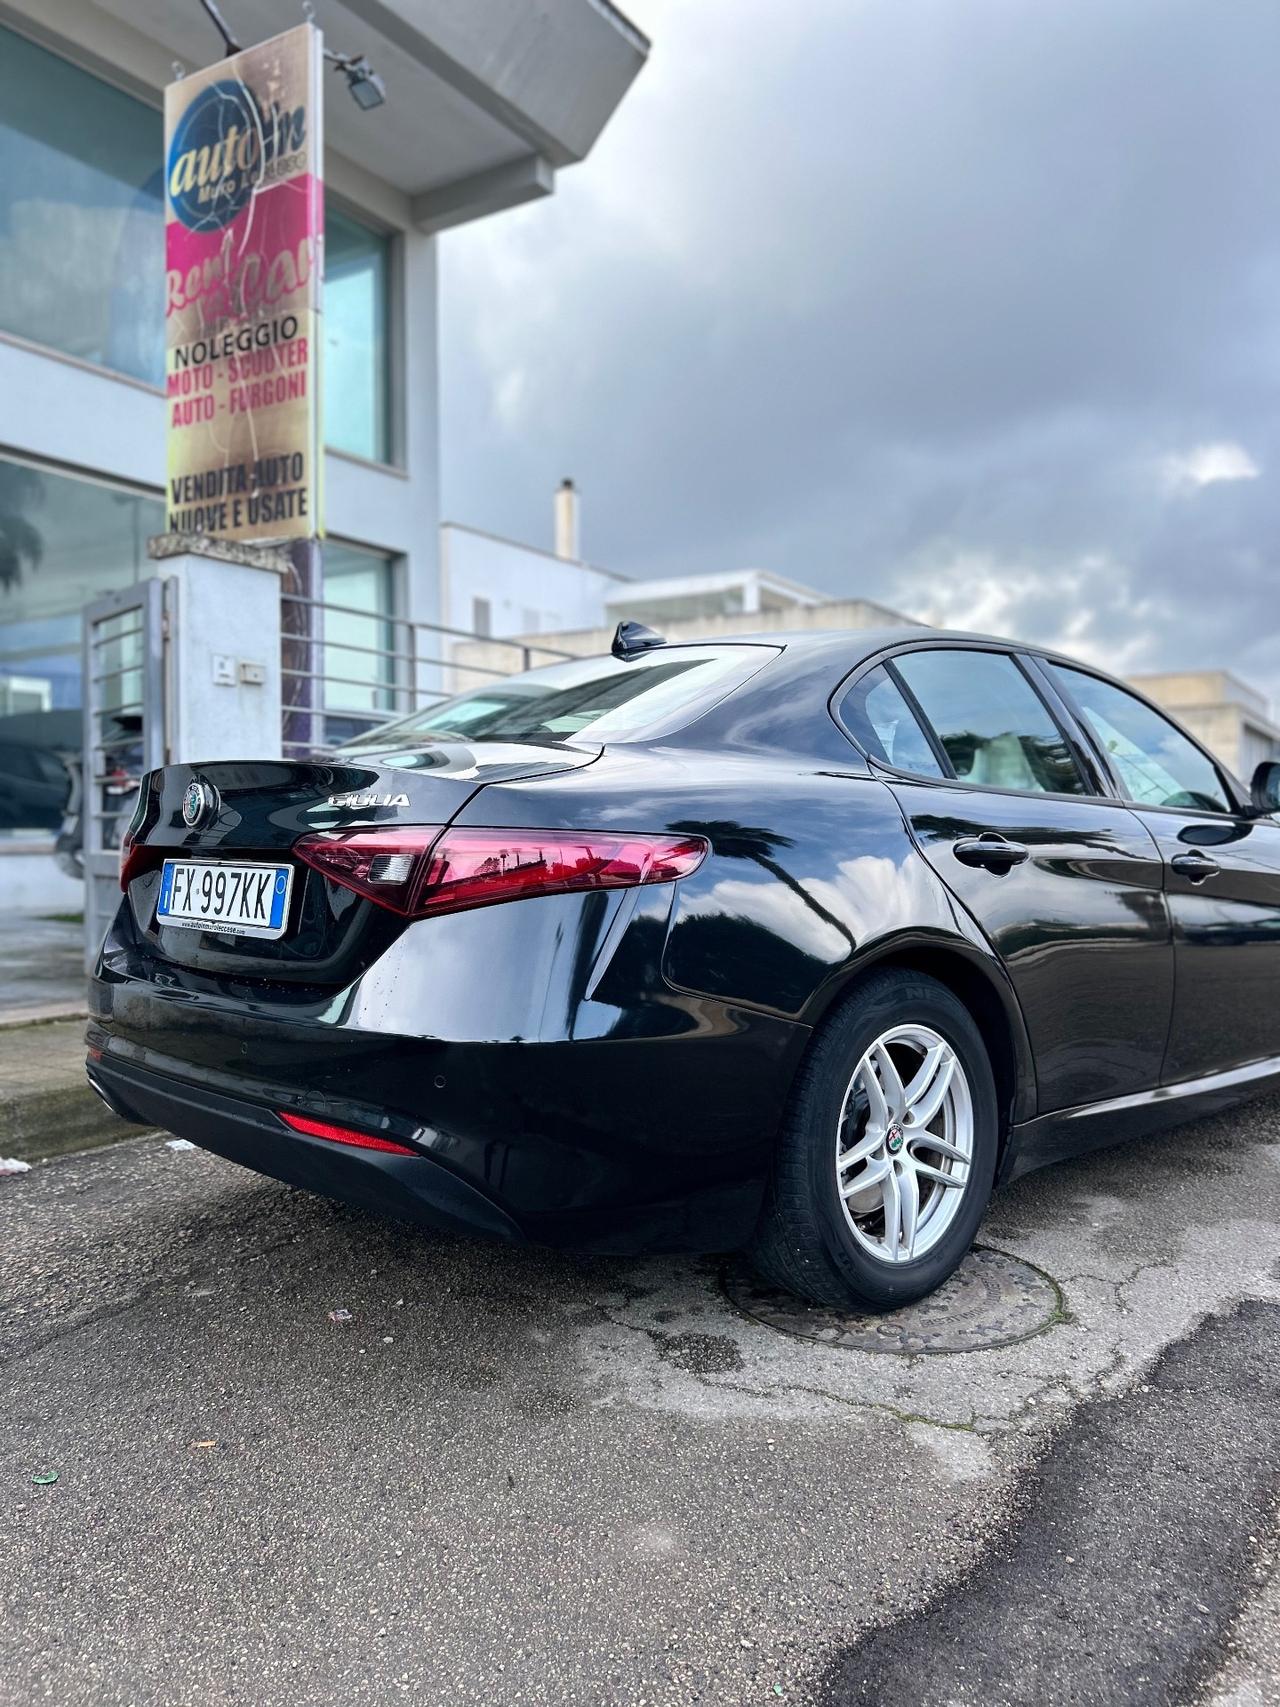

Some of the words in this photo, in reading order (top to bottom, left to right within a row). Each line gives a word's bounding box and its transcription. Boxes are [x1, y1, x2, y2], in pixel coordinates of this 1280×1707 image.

[167, 364, 213, 399] MOTO
[228, 337, 308, 383] SCOOTER
[174, 316, 298, 368] NOLEGGIO
[172, 394, 214, 429] AUTO
[229, 370, 307, 415] FURGONI
[171, 464, 248, 504] VENDITA
[252, 451, 304, 488] AUTO
[169, 503, 228, 534] NUOVE
[232, 500, 242, 529] E
[247, 488, 307, 525] USATE
[328, 793, 411, 808] GIULIA
